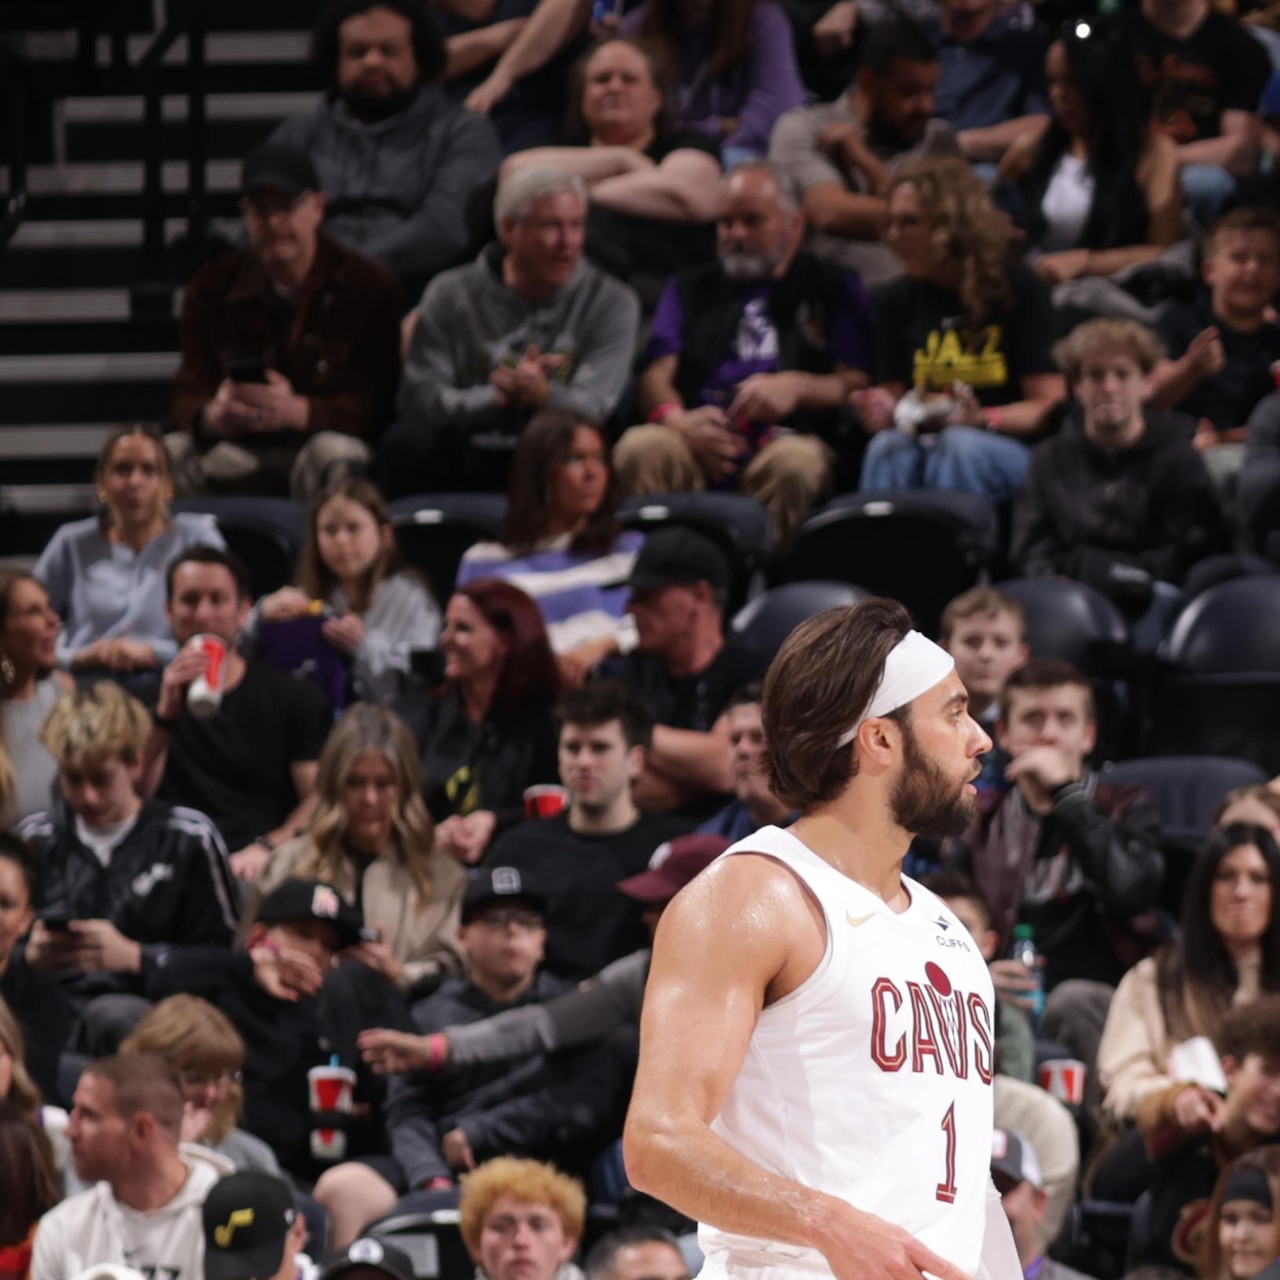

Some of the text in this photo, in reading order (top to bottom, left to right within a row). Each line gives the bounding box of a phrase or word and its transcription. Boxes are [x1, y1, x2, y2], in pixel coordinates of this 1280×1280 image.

[936, 935, 971, 952] CLIFFS
[871, 977, 993, 1086] CAVS
[936, 1099, 957, 1204] 1
